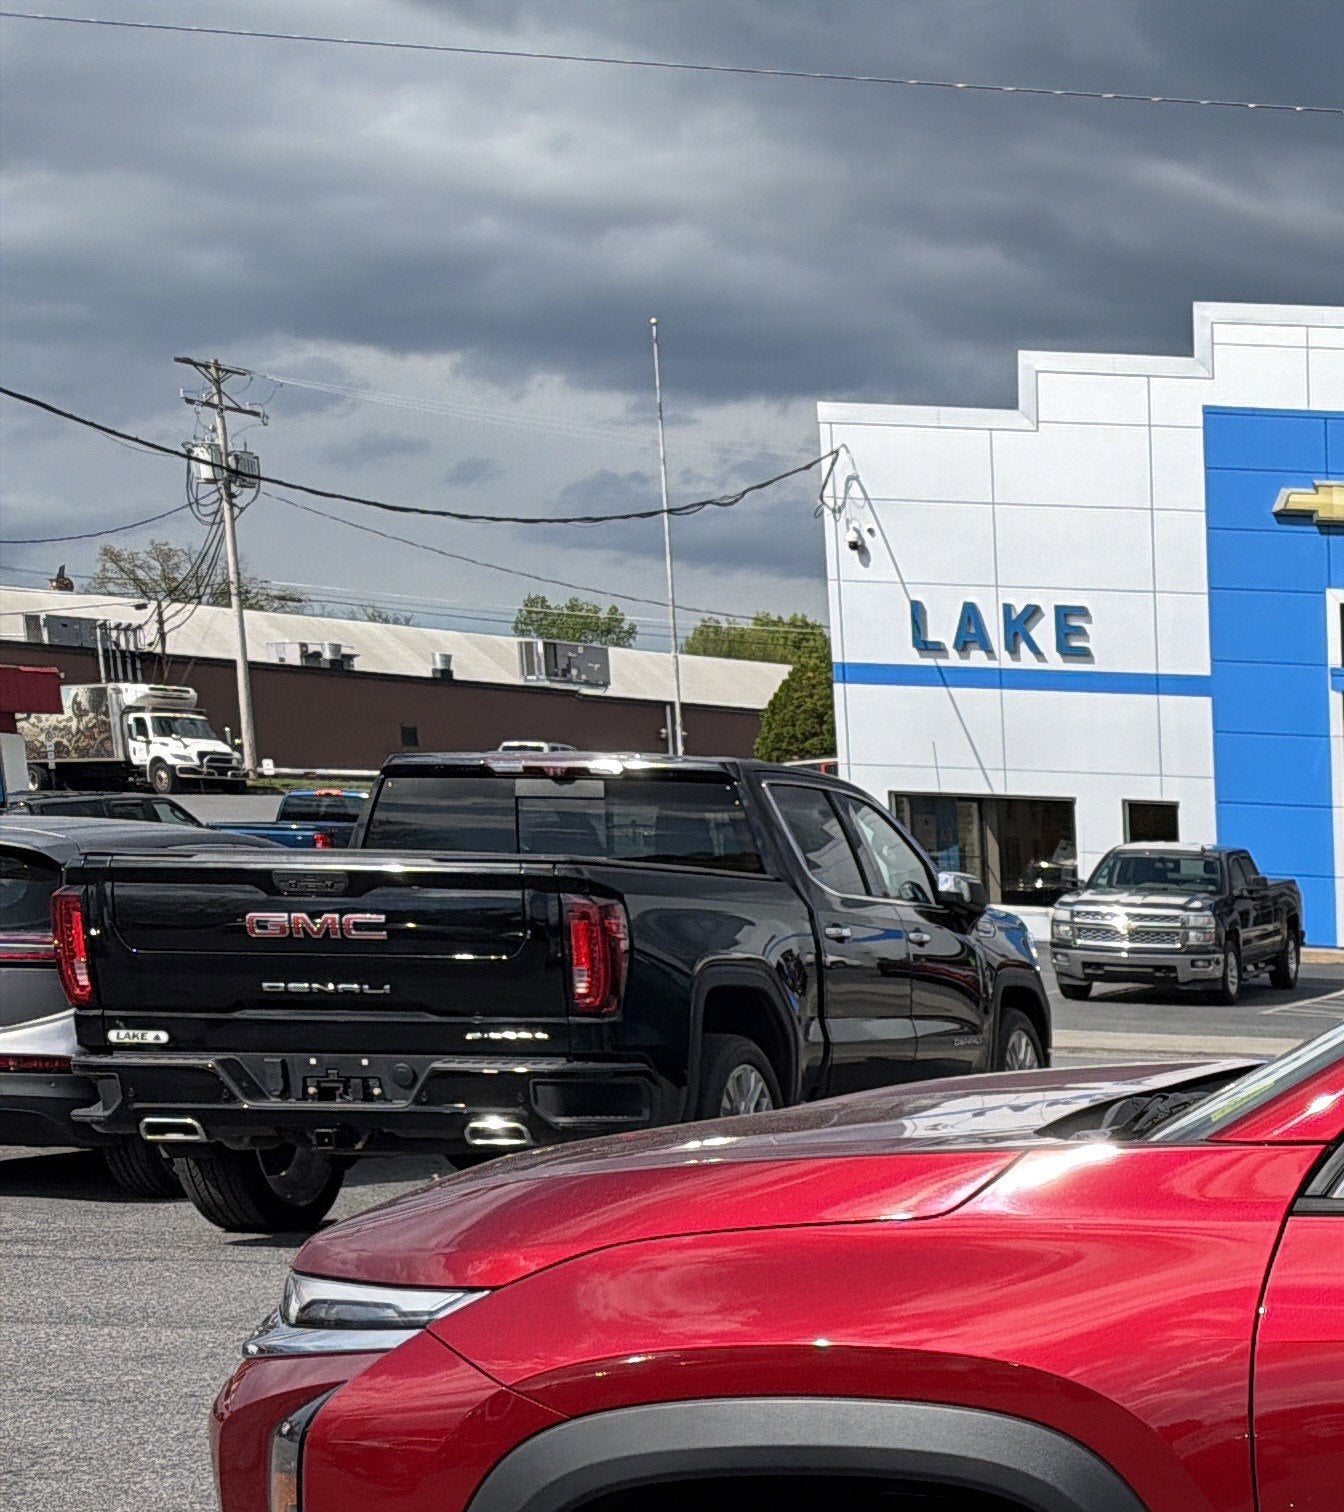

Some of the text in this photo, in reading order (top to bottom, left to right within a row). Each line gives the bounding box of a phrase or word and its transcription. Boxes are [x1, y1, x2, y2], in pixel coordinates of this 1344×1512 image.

[909, 599, 1092, 656] LAKE
[245, 912, 388, 940] GMC
[261, 981, 391, 994] DENALI
[115, 1031, 149, 1041] LAKE
